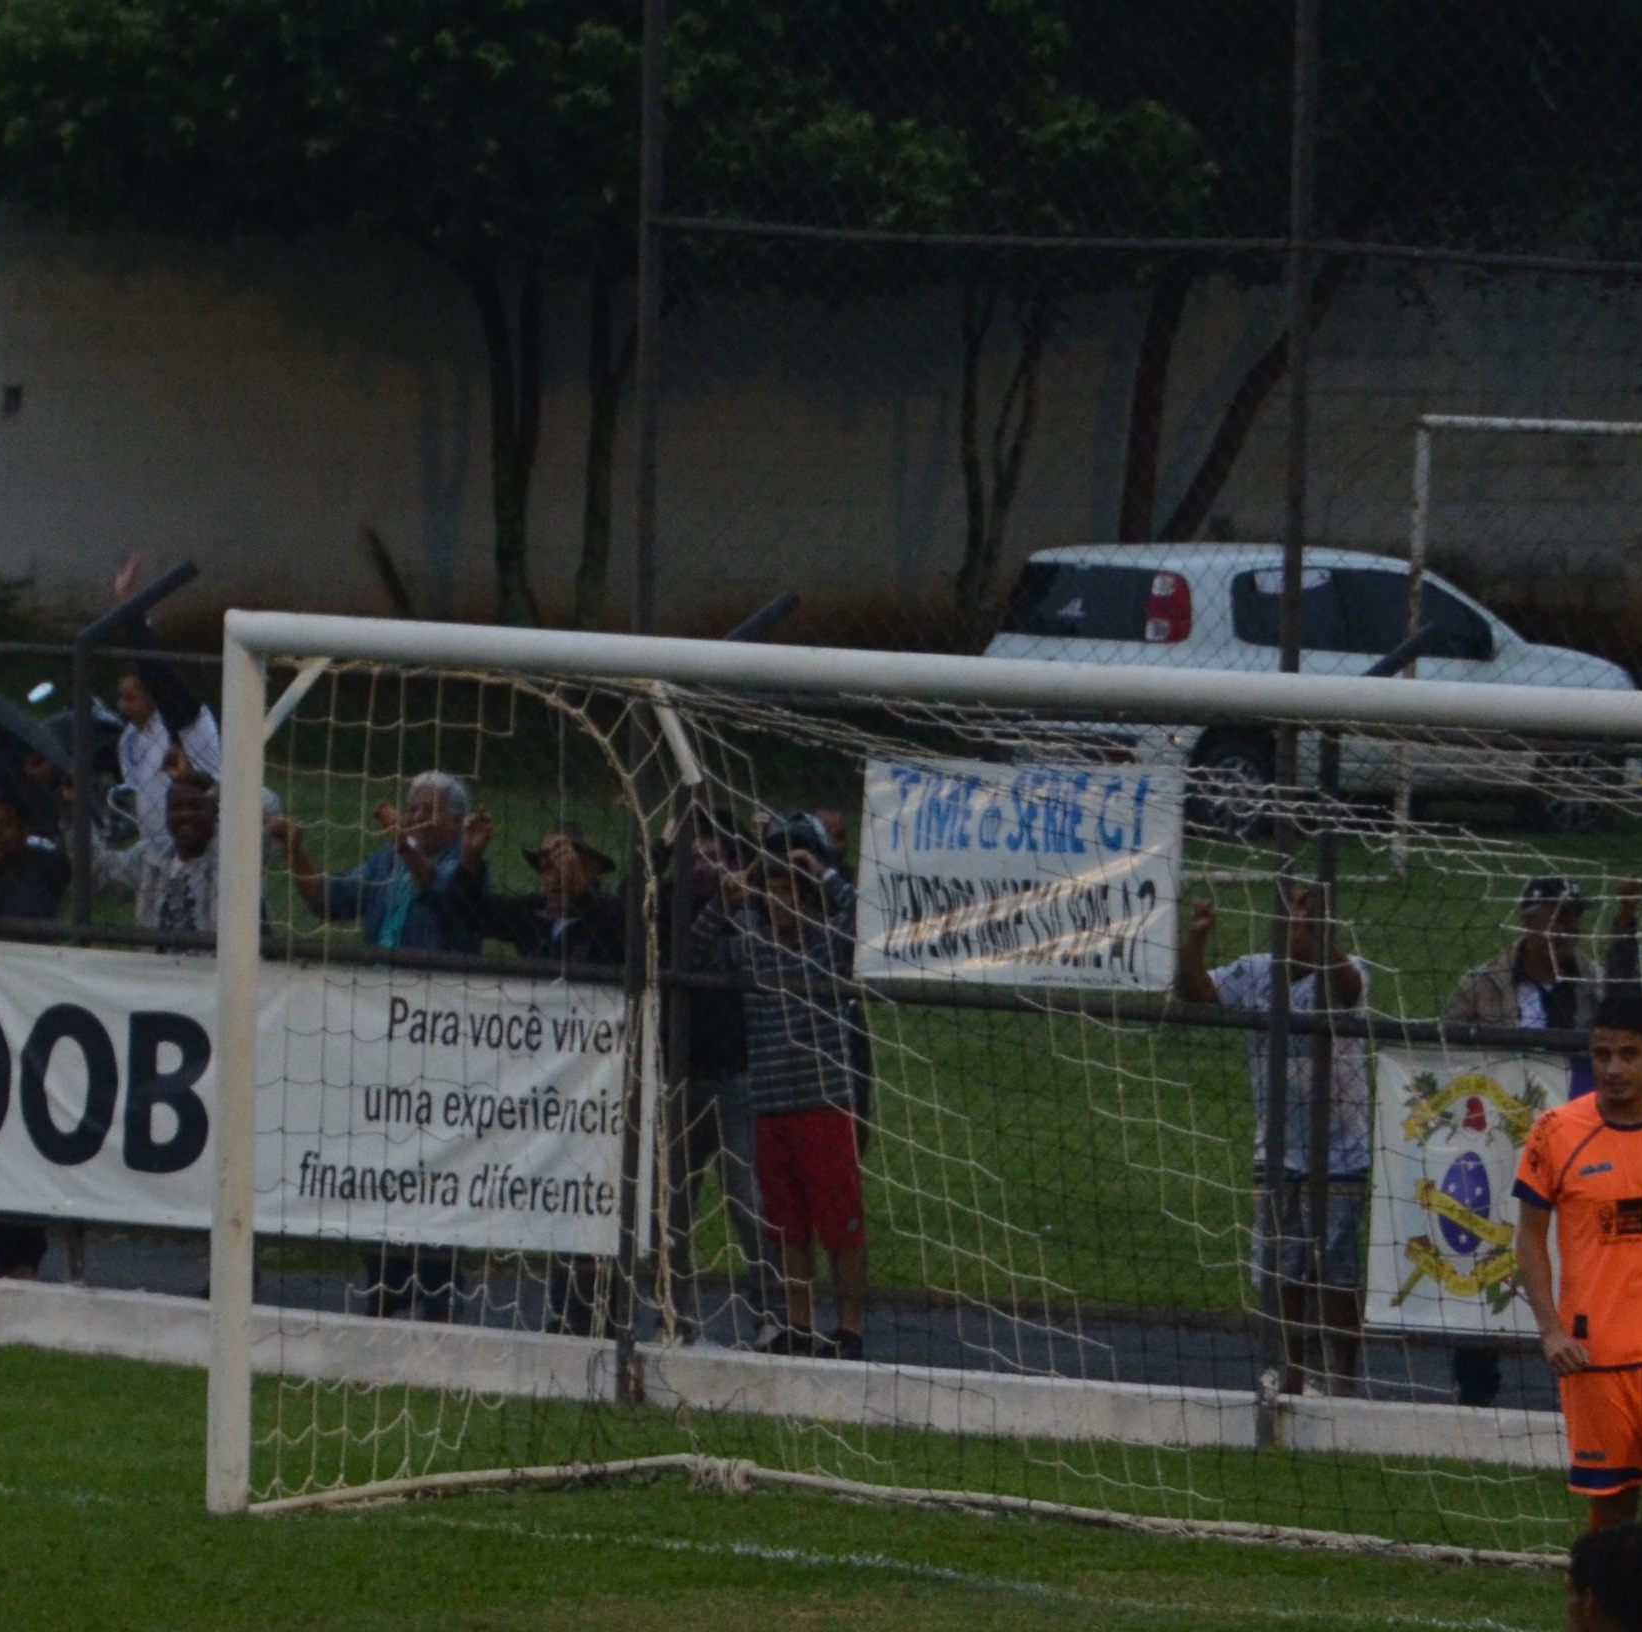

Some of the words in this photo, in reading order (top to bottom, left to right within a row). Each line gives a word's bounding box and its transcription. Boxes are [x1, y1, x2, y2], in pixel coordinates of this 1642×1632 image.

[388, 997, 458, 1047] Para
[470, 1004, 542, 1052] você
[364, 1087, 432, 1125] uma
[442, 1086, 624, 1139] experiência
[298, 1150, 458, 1207] financeira
